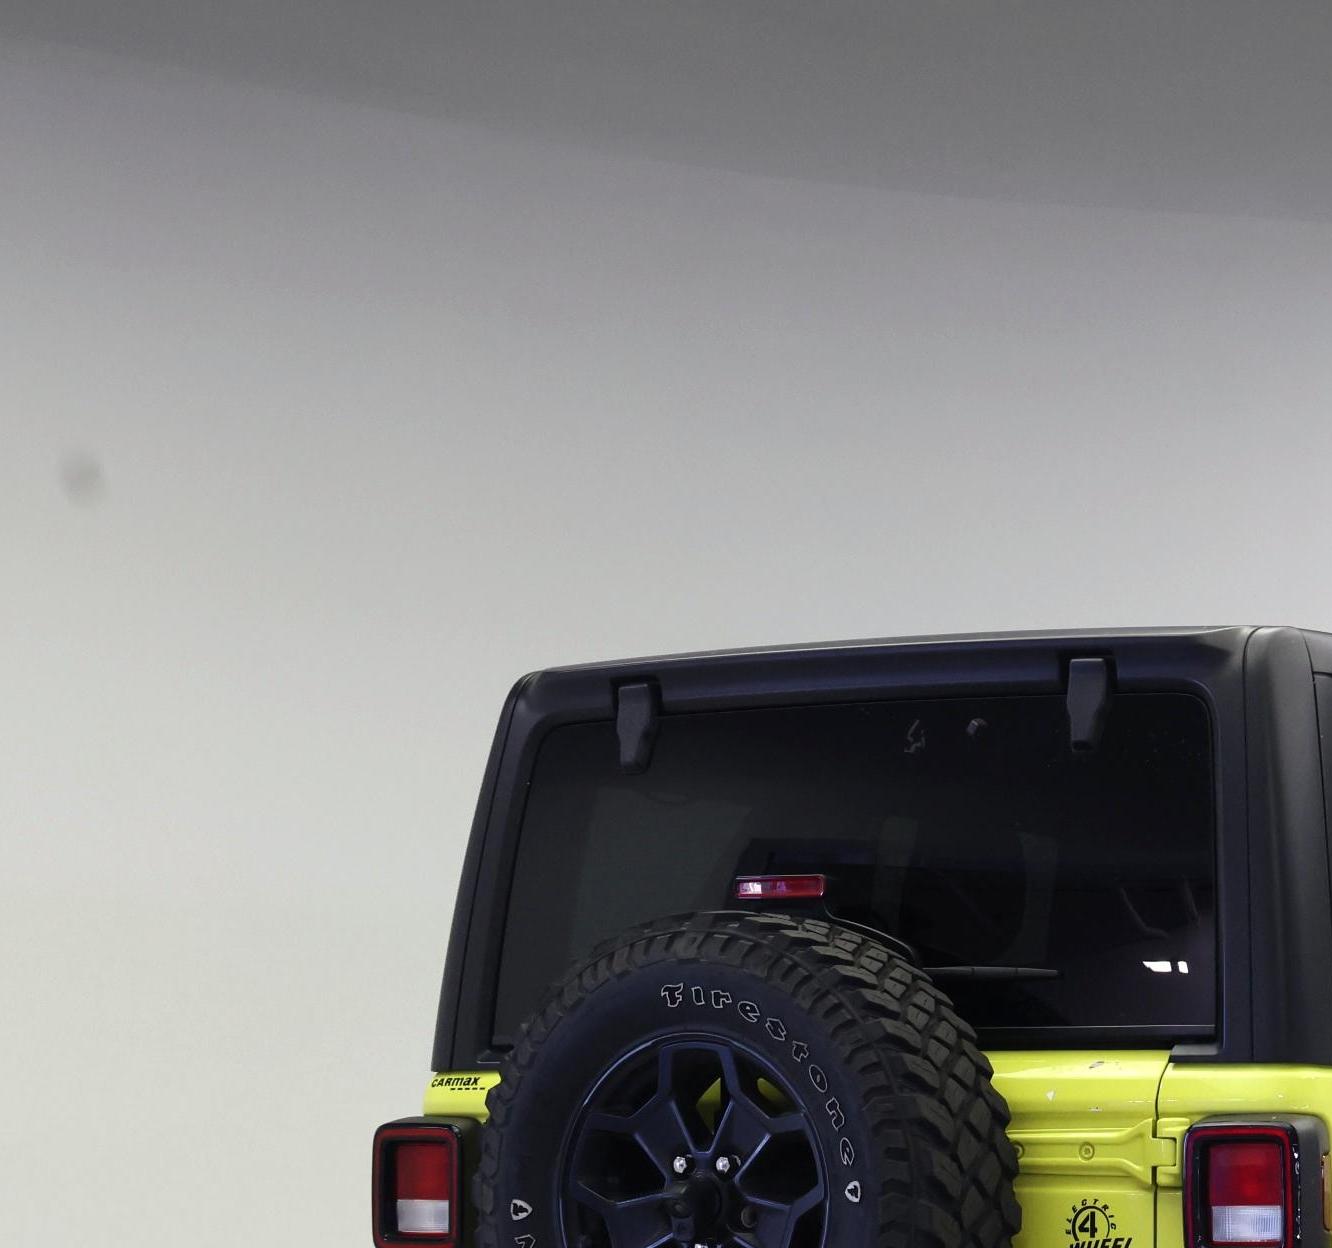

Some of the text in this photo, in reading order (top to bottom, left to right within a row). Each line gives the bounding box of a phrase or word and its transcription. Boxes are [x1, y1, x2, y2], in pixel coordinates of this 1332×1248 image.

[661, 983, 855, 1166] Firestone
[1065, 1198, 1117, 1235] ELECTRIC
[1078, 1211, 1098, 1238] 4
